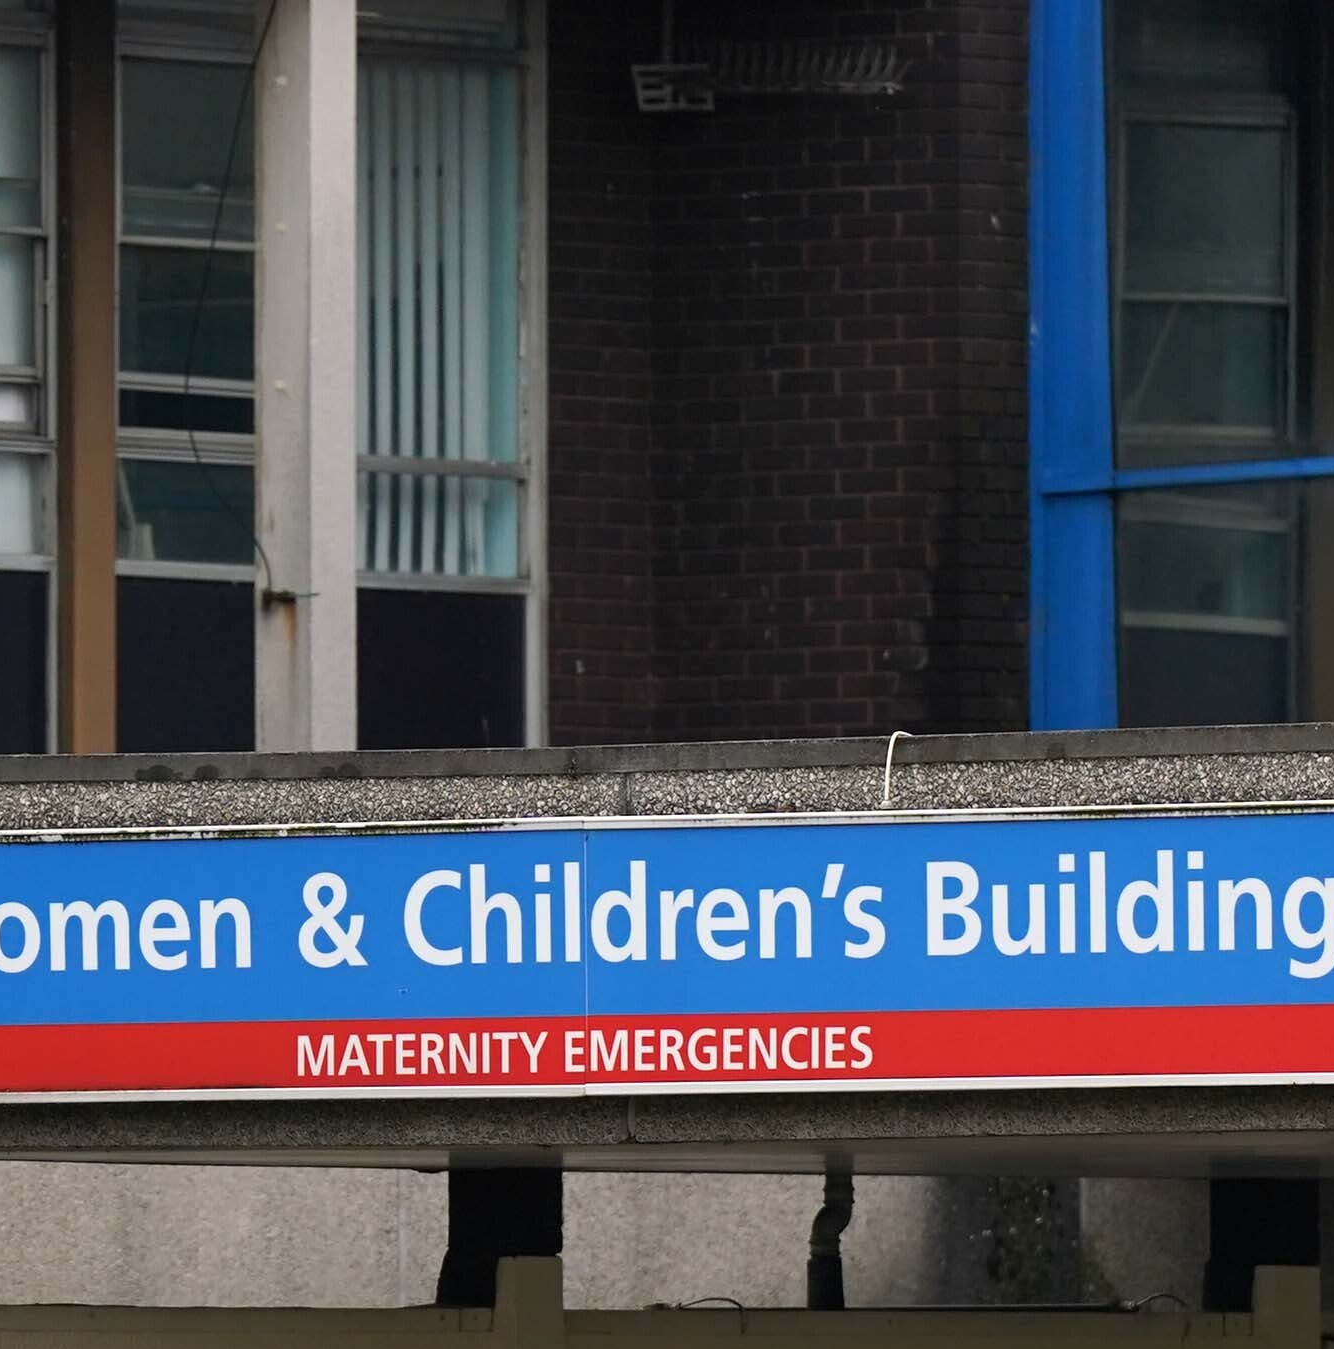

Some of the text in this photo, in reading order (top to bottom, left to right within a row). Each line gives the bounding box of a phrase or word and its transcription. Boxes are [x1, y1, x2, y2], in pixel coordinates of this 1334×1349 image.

[298, 872, 369, 967] &
[403, 861, 885, 966] Children's
[296, 1026, 873, 1077] MATERNITY EMERGENCIES
